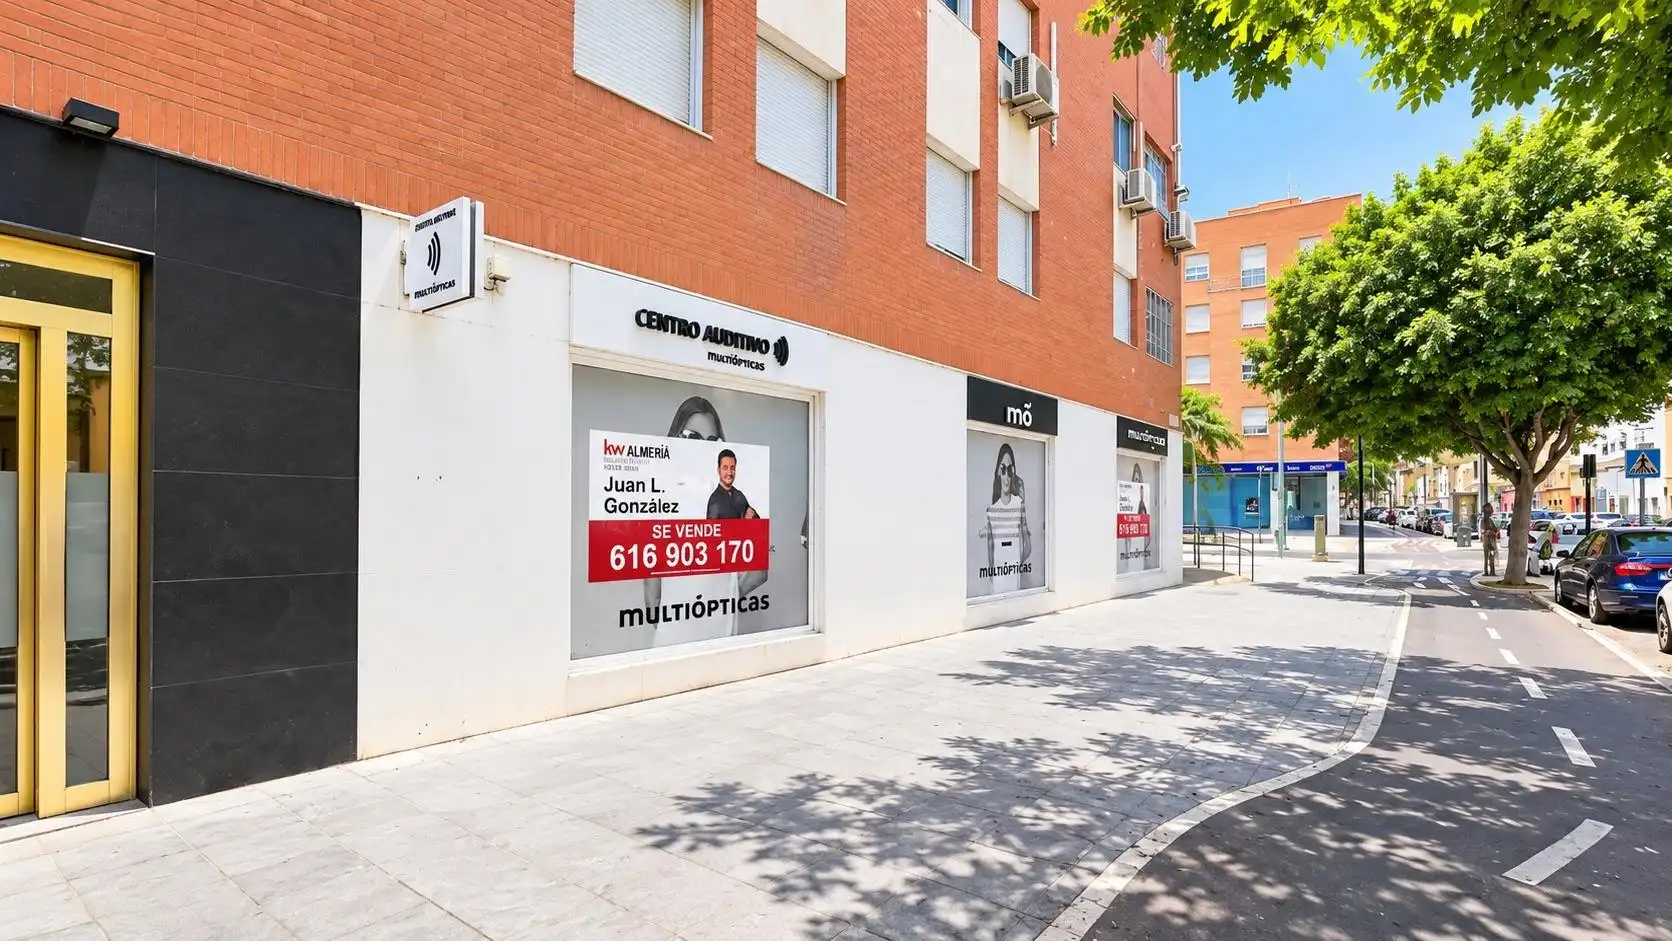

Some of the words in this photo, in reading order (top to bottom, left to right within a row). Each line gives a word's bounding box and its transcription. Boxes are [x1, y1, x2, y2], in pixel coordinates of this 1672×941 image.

[635, 308, 700, 339] CENTRO
[702, 325, 770, 355] AUDITIVO
[603, 438, 626, 456] kw
[603, 476, 646, 493] Juan
[651, 477, 666, 493] L.
[603, 494, 680, 514] González
[652, 524, 672, 539] SE
[675, 523, 722, 538] VENDE
[609, 543, 658, 572] 616
[665, 541, 709, 568] 903
[716, 539, 754, 564] 170
